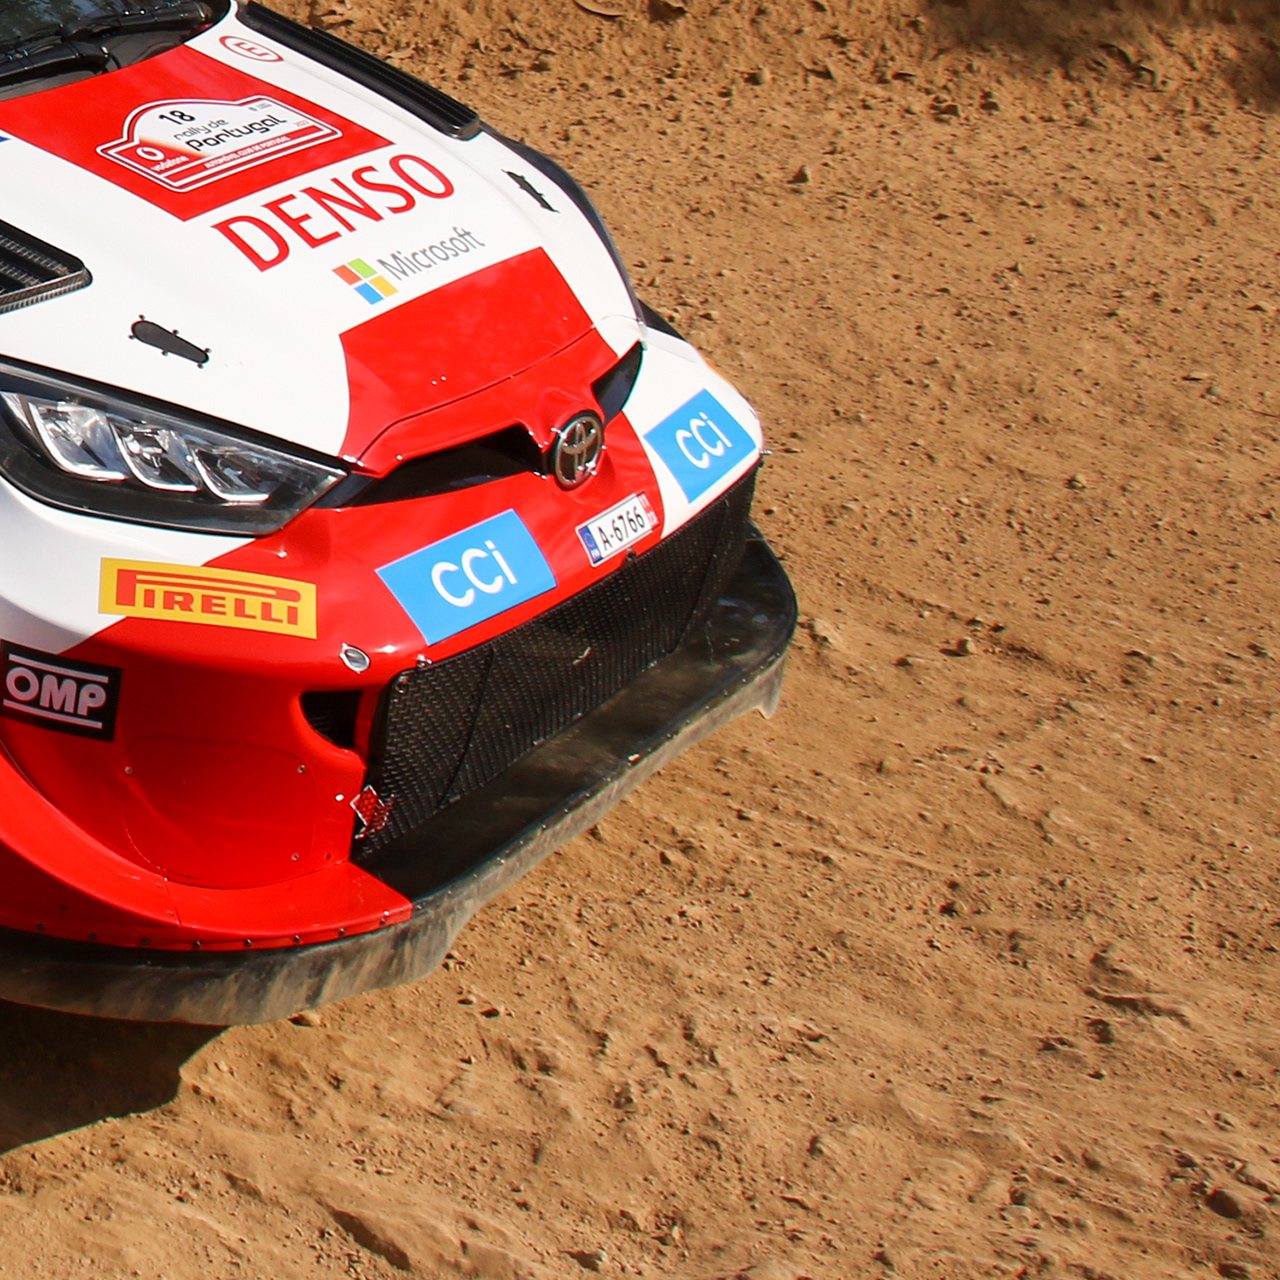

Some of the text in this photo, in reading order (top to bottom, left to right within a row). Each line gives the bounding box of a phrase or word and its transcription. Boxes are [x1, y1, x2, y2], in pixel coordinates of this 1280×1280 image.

[233, 42, 271, 57] E
[158, 110, 196, 126] 18
[173, 119, 229, 141] rally de
[185, 114, 287, 152] Portugal
[210, 153, 455, 272] DENSO
[378, 225, 486, 282] Microsoft
[115, 568, 302, 626] PIRELLI
[4, 666, 108, 717] OMP
